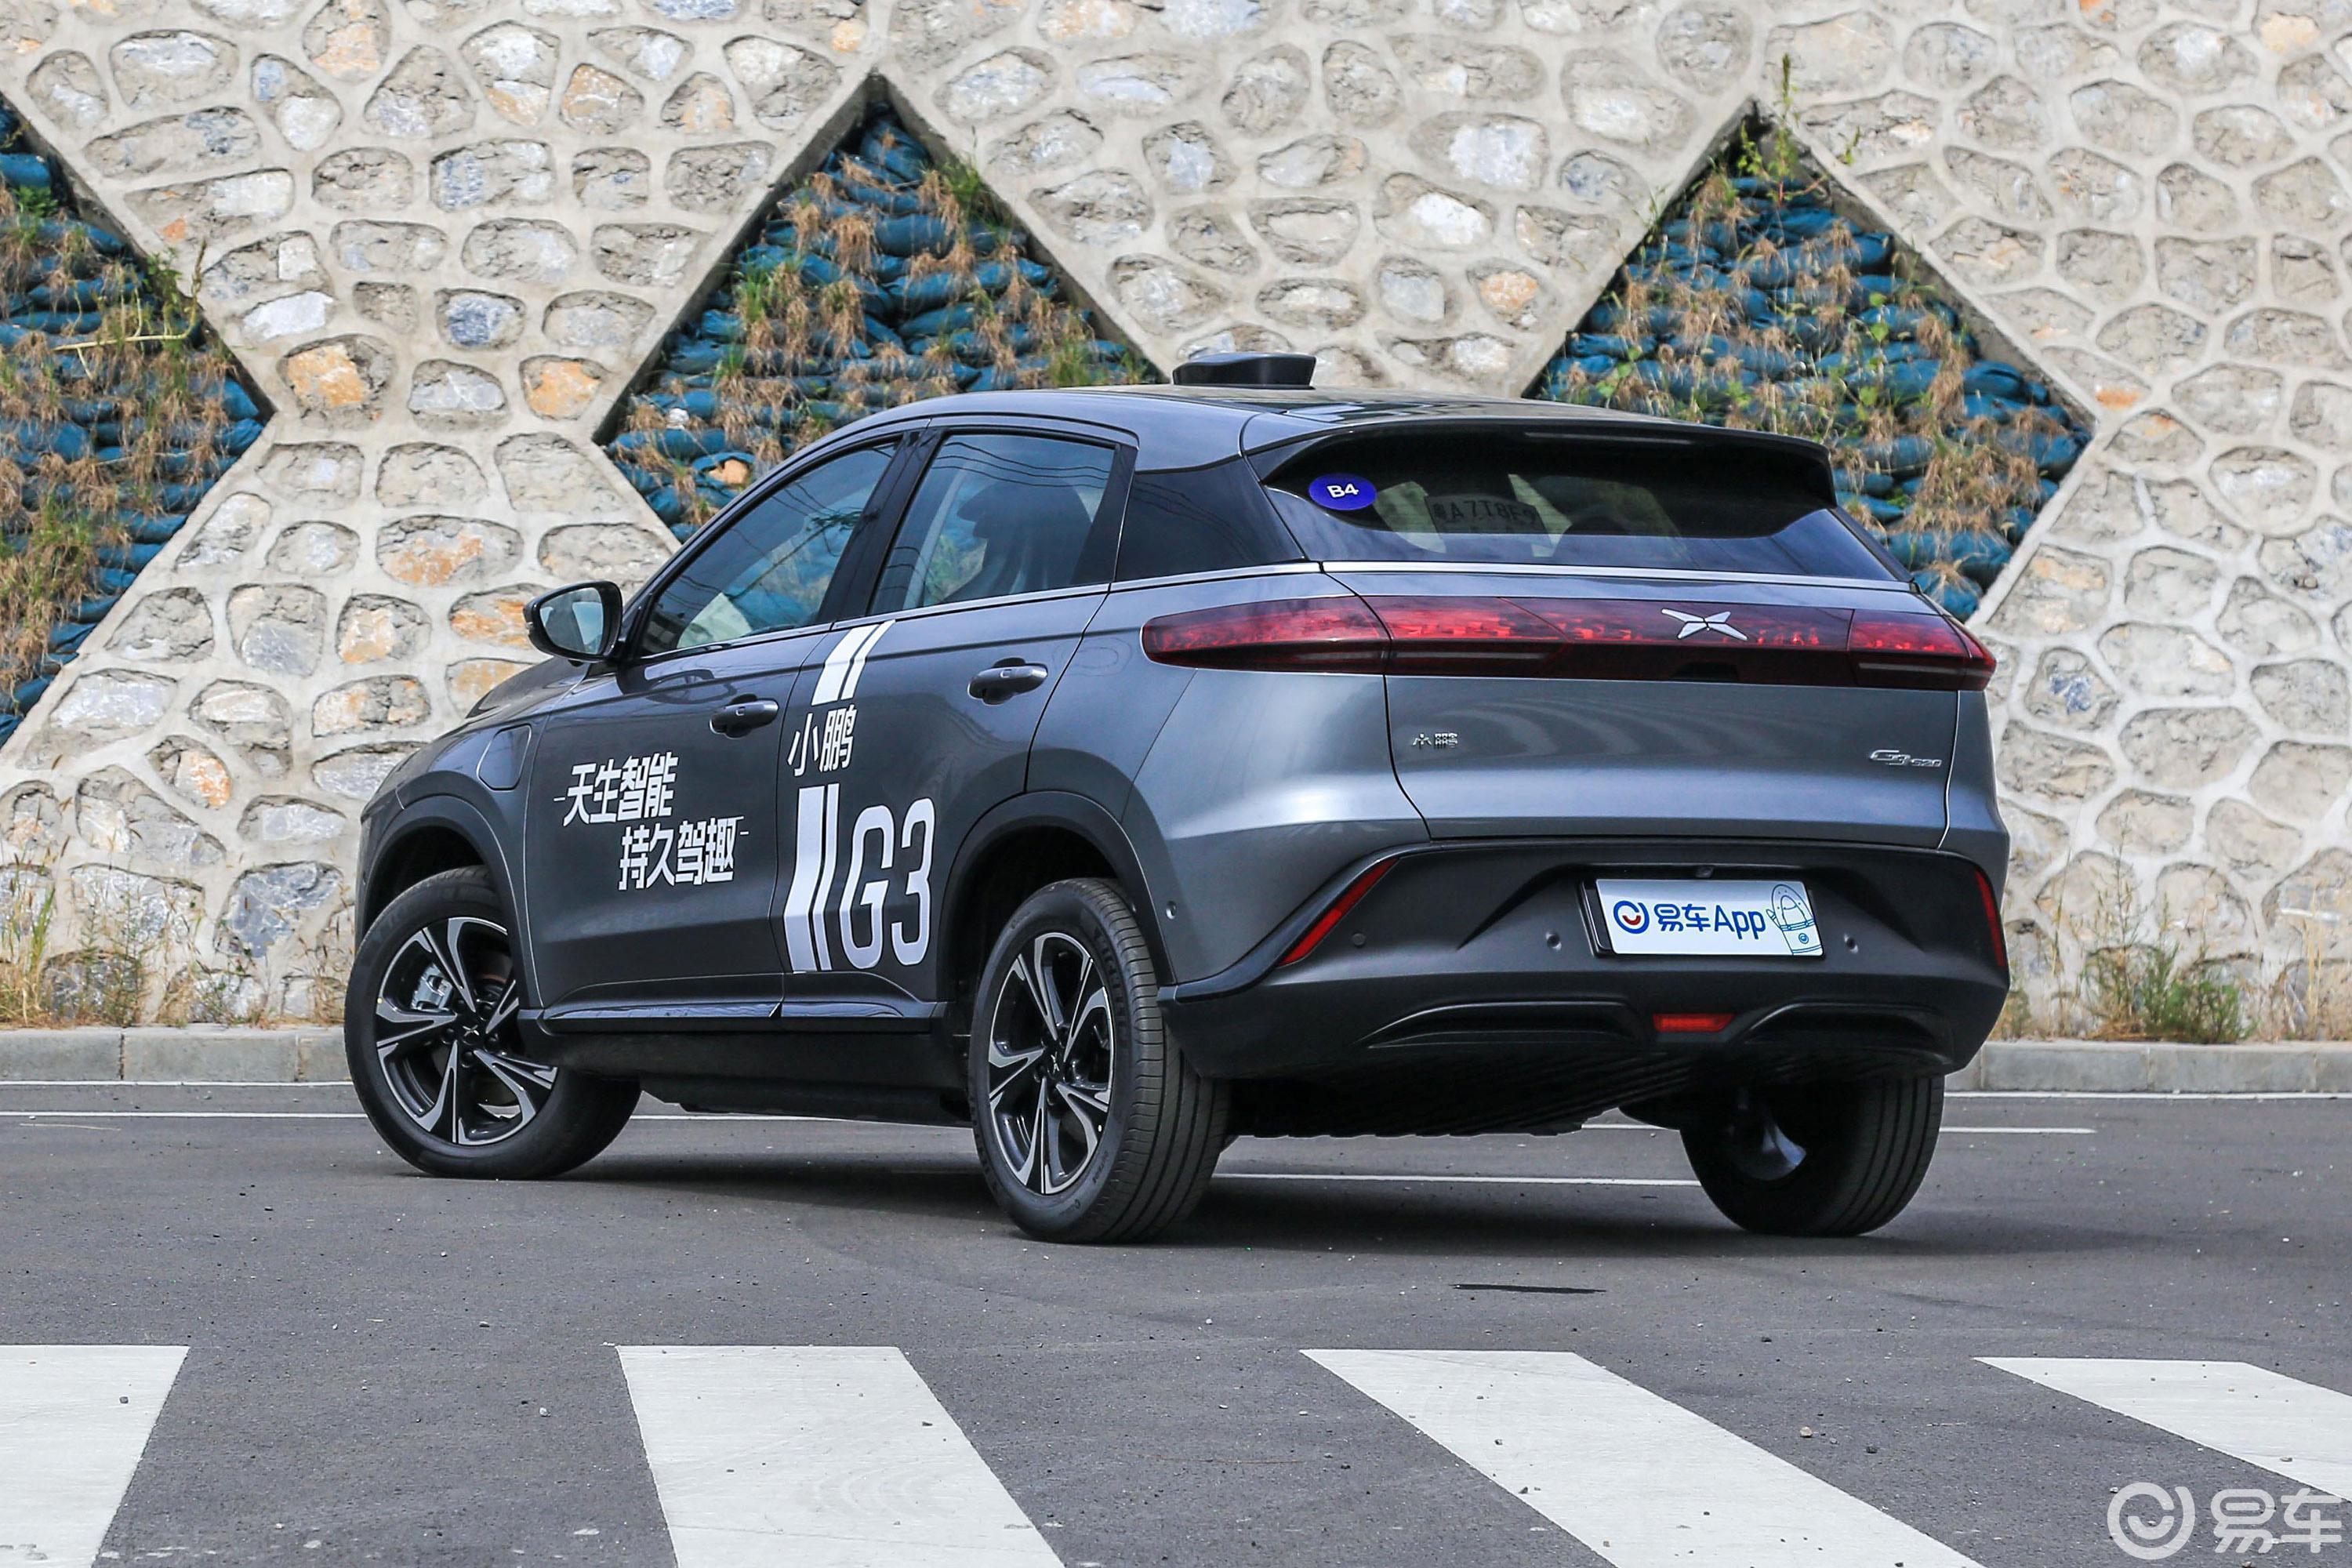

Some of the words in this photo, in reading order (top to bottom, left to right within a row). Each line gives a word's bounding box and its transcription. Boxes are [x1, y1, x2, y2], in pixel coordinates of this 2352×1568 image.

[1327, 483, 1359, 498] B4
[787, 704, 857, 777] 小鹏
[563, 751, 680, 827] 天生智能
[618, 816, 744, 891] 持久驾趣
[839, 797, 935, 970] G3
